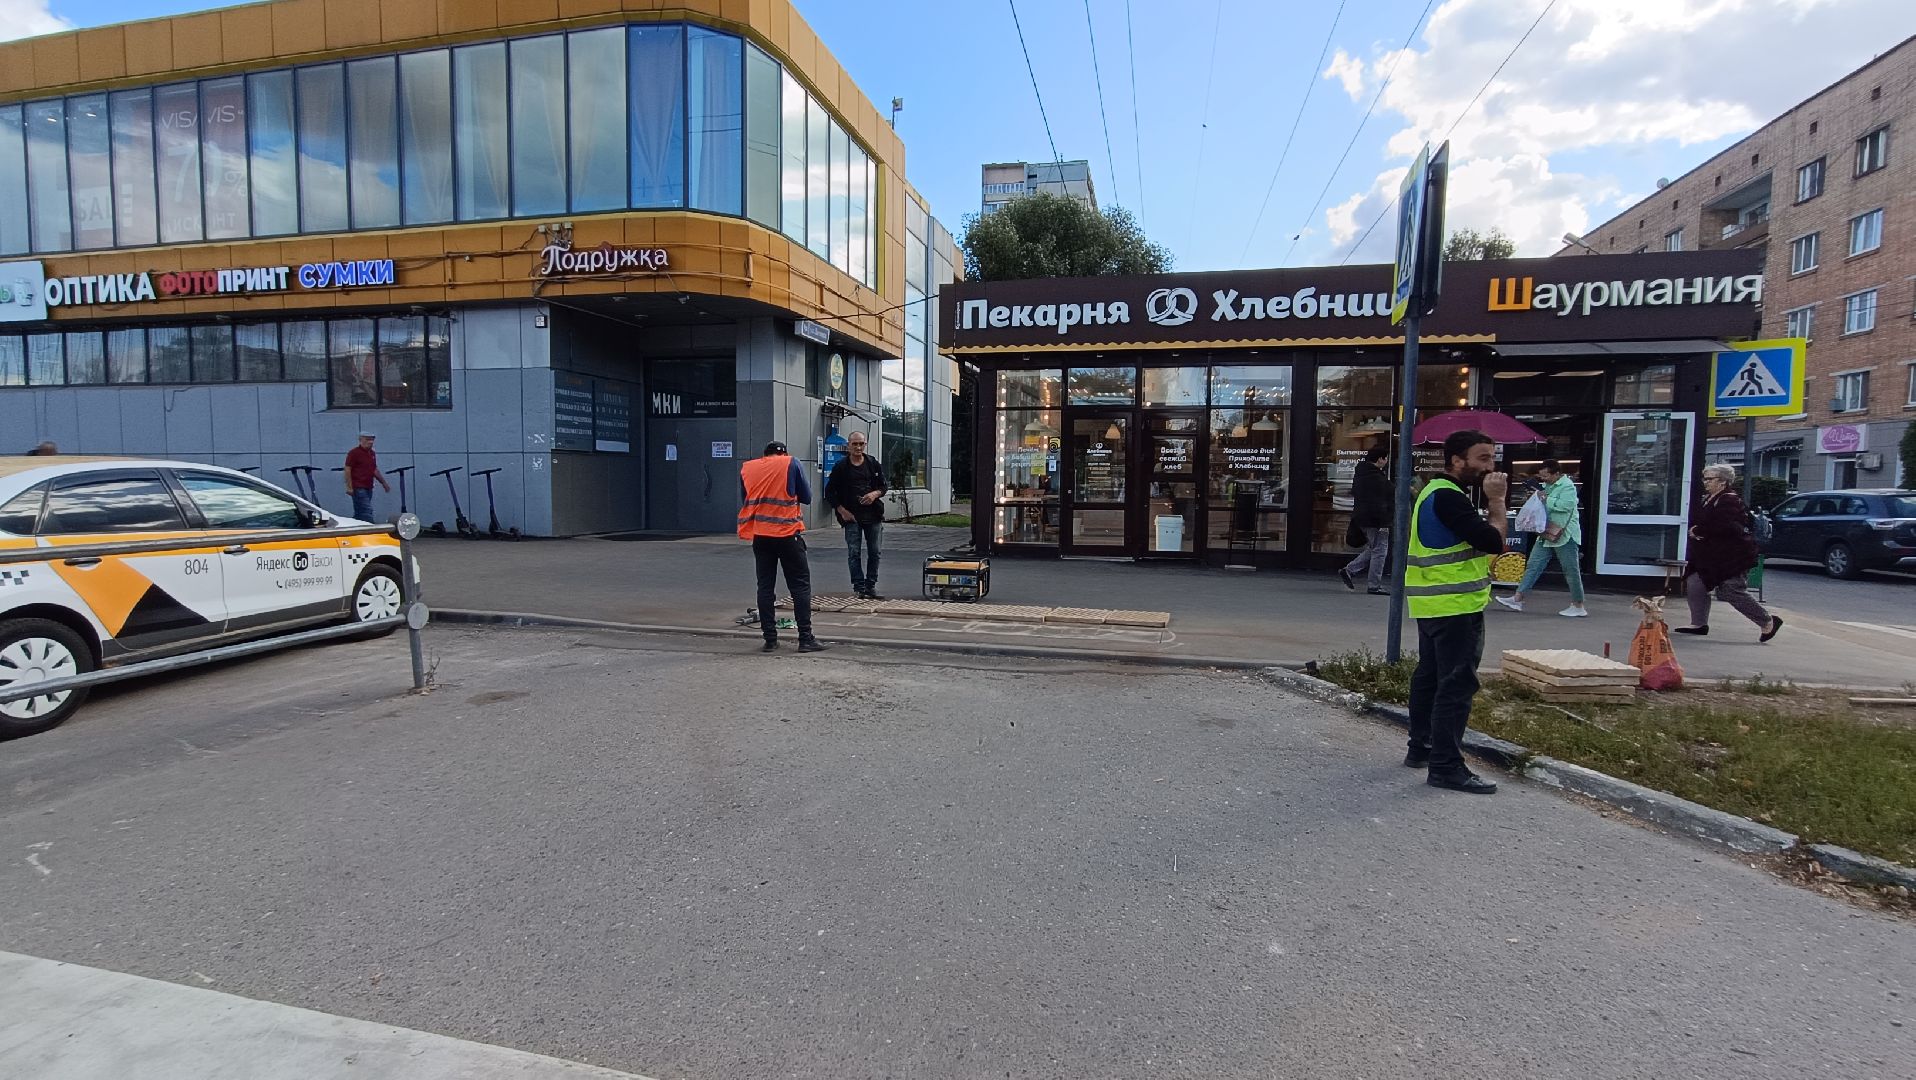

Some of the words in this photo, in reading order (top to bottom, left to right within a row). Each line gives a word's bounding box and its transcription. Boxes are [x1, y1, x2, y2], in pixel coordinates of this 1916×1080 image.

[541, 241, 670, 275] Подружка
[160, 266, 290, 295] ФОТОПРИНТ
[299, 259, 394, 289] СУМКИ
[45, 272, 157, 306] ОПТИКА
[1488, 274, 1764, 316] Шаурмания
[963, 298, 1131, 335] Пекарня
[1411, 449, 1439, 458] орячий
[184, 558, 209, 576] 804
[256, 556, 291, 572] Яндекс
[293, 553, 309, 570] Go
[311, 553, 333, 568] Такси
[285, 577, 302, 590] (495)
[303, 577, 315, 588] 999
[315, 576, 324, 587] 99
[324, 575, 333, 586] 99
